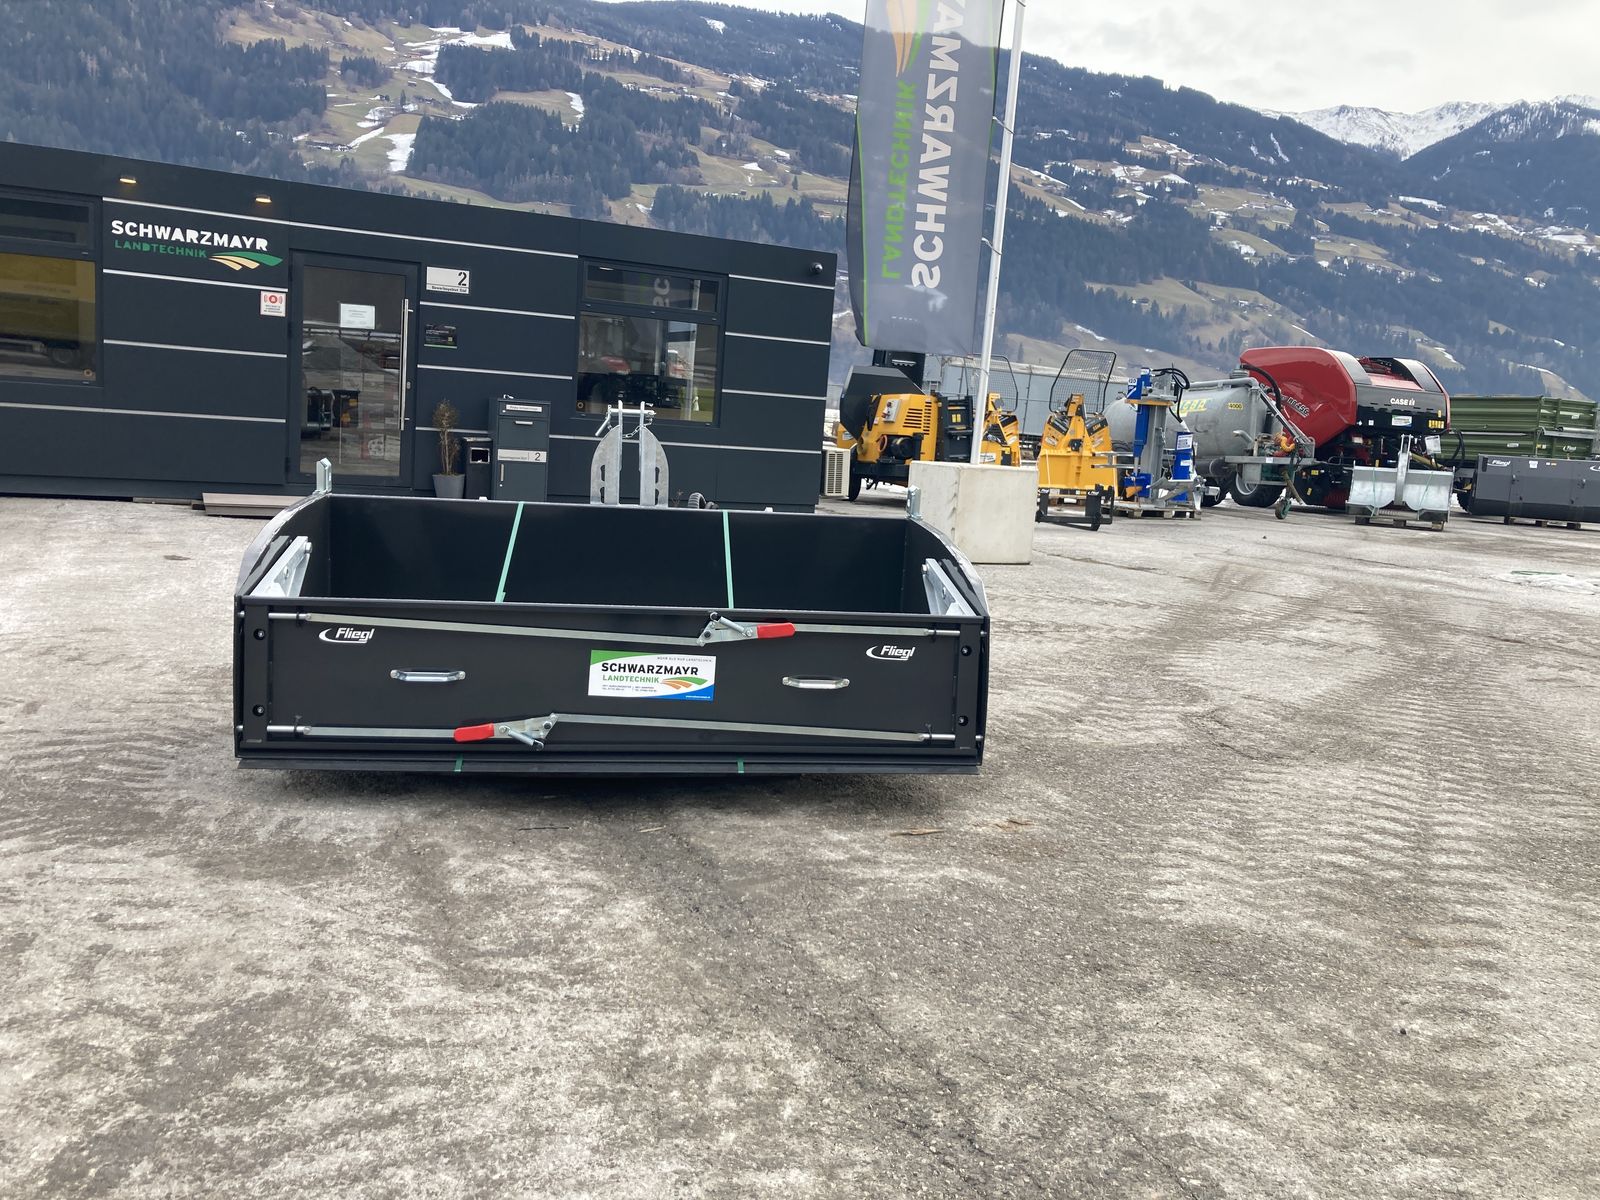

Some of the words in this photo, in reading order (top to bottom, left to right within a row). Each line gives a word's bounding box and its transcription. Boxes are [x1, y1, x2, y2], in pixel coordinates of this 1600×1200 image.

[111, 219, 269, 252] SCHWARZMAYR
[114, 239, 208, 259] LANDTECHNIK
[457, 271, 467, 286] 2
[1390, 397, 1409, 406] CASE
[534, 452, 541, 461] 2
[335, 627, 375, 643] Fliegl
[880, 645, 916, 660] Fliegl
[601, 662, 699, 676] SCHWARZMAYR
[602, 674, 660, 684] LANDTECHNIK
